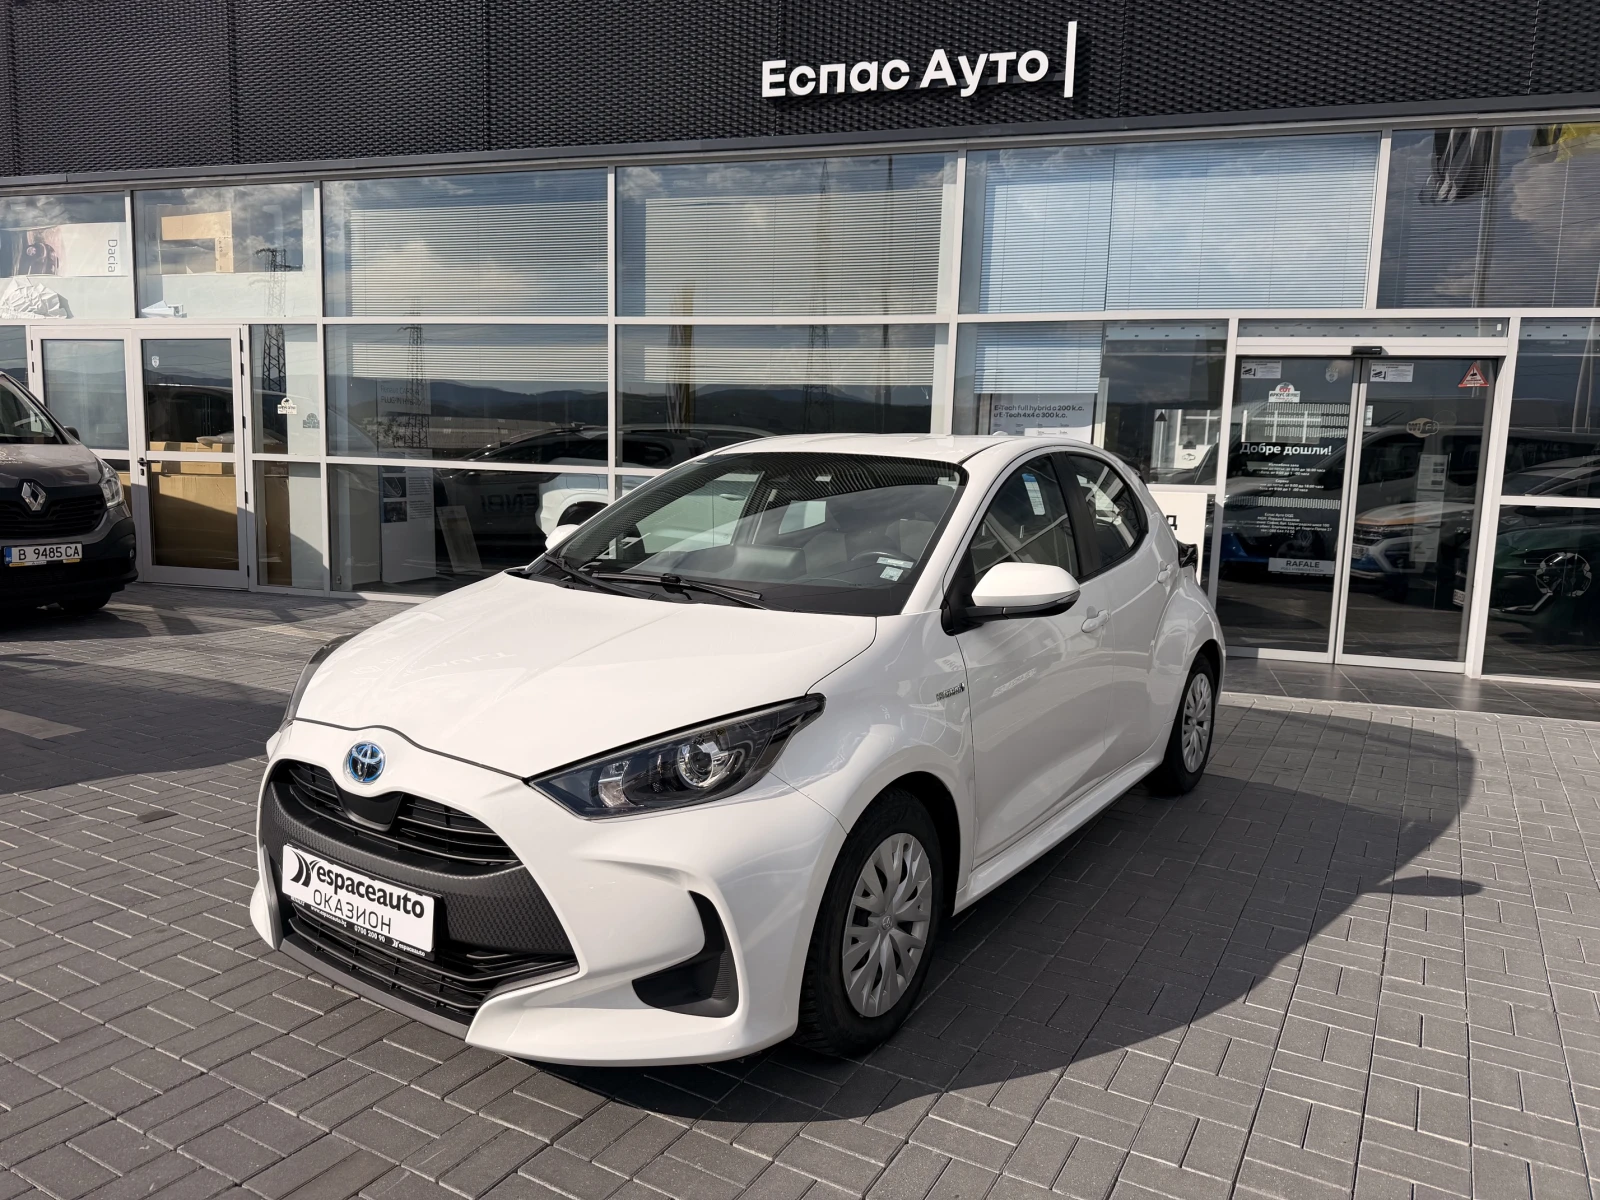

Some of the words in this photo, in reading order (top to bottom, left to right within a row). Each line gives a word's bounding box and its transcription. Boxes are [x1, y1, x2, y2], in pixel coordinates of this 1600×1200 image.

[762, 59, 910, 98] Еспас
[919, 48, 1049, 98] Ауто
[108, 239, 118, 273] Dacia
[1030, 404, 1051, 413] hybrid
[1239, 442, 1281, 456] Добре
[1283, 445, 1332, 456] дошли!
[33, 547, 63, 560] 9485
[64, 545, 80, 558] CA
[1286, 560, 1320, 568] RAFALE
[316, 865, 425, 919] espaceauto
[313, 889, 392, 935] ОКАЗИОН
